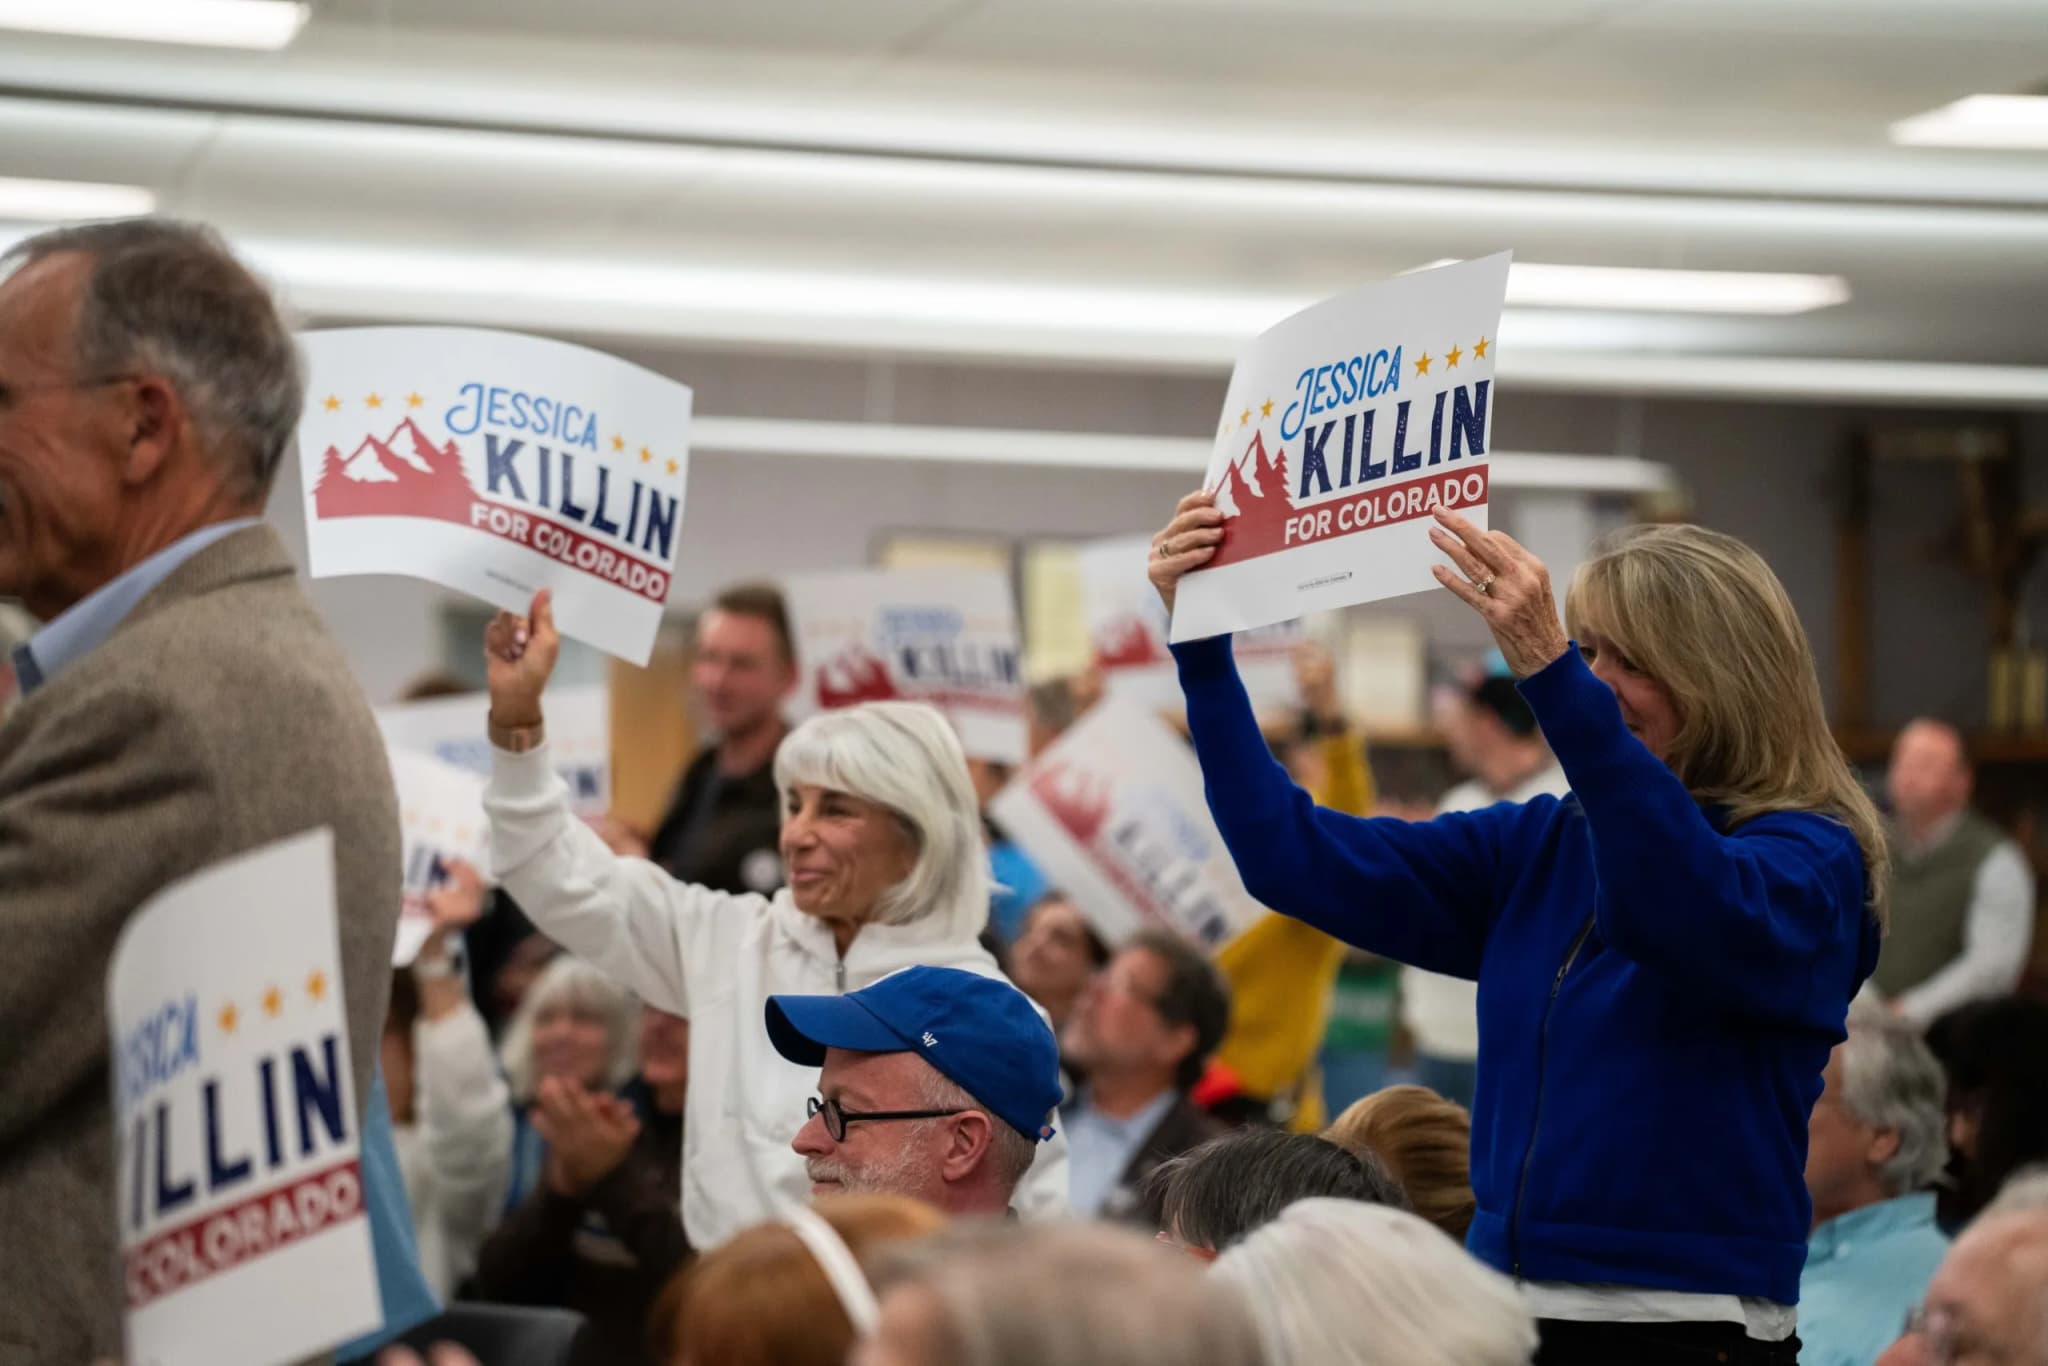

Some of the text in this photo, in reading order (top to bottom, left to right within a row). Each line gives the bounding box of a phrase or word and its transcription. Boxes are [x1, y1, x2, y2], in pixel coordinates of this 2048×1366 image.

[445, 383, 599, 452] JESSICA
[1280, 344, 1402, 441] JESSICA
[1298, 379, 1490, 500] KILLIN
[484, 433, 680, 561] KILLIN
[1284, 473, 1484, 545] FOR COLORADO
[471, 502, 530, 543] FOR
[533, 525, 666, 600] COLORADO
[130, 1034, 348, 1233] ILLIN
